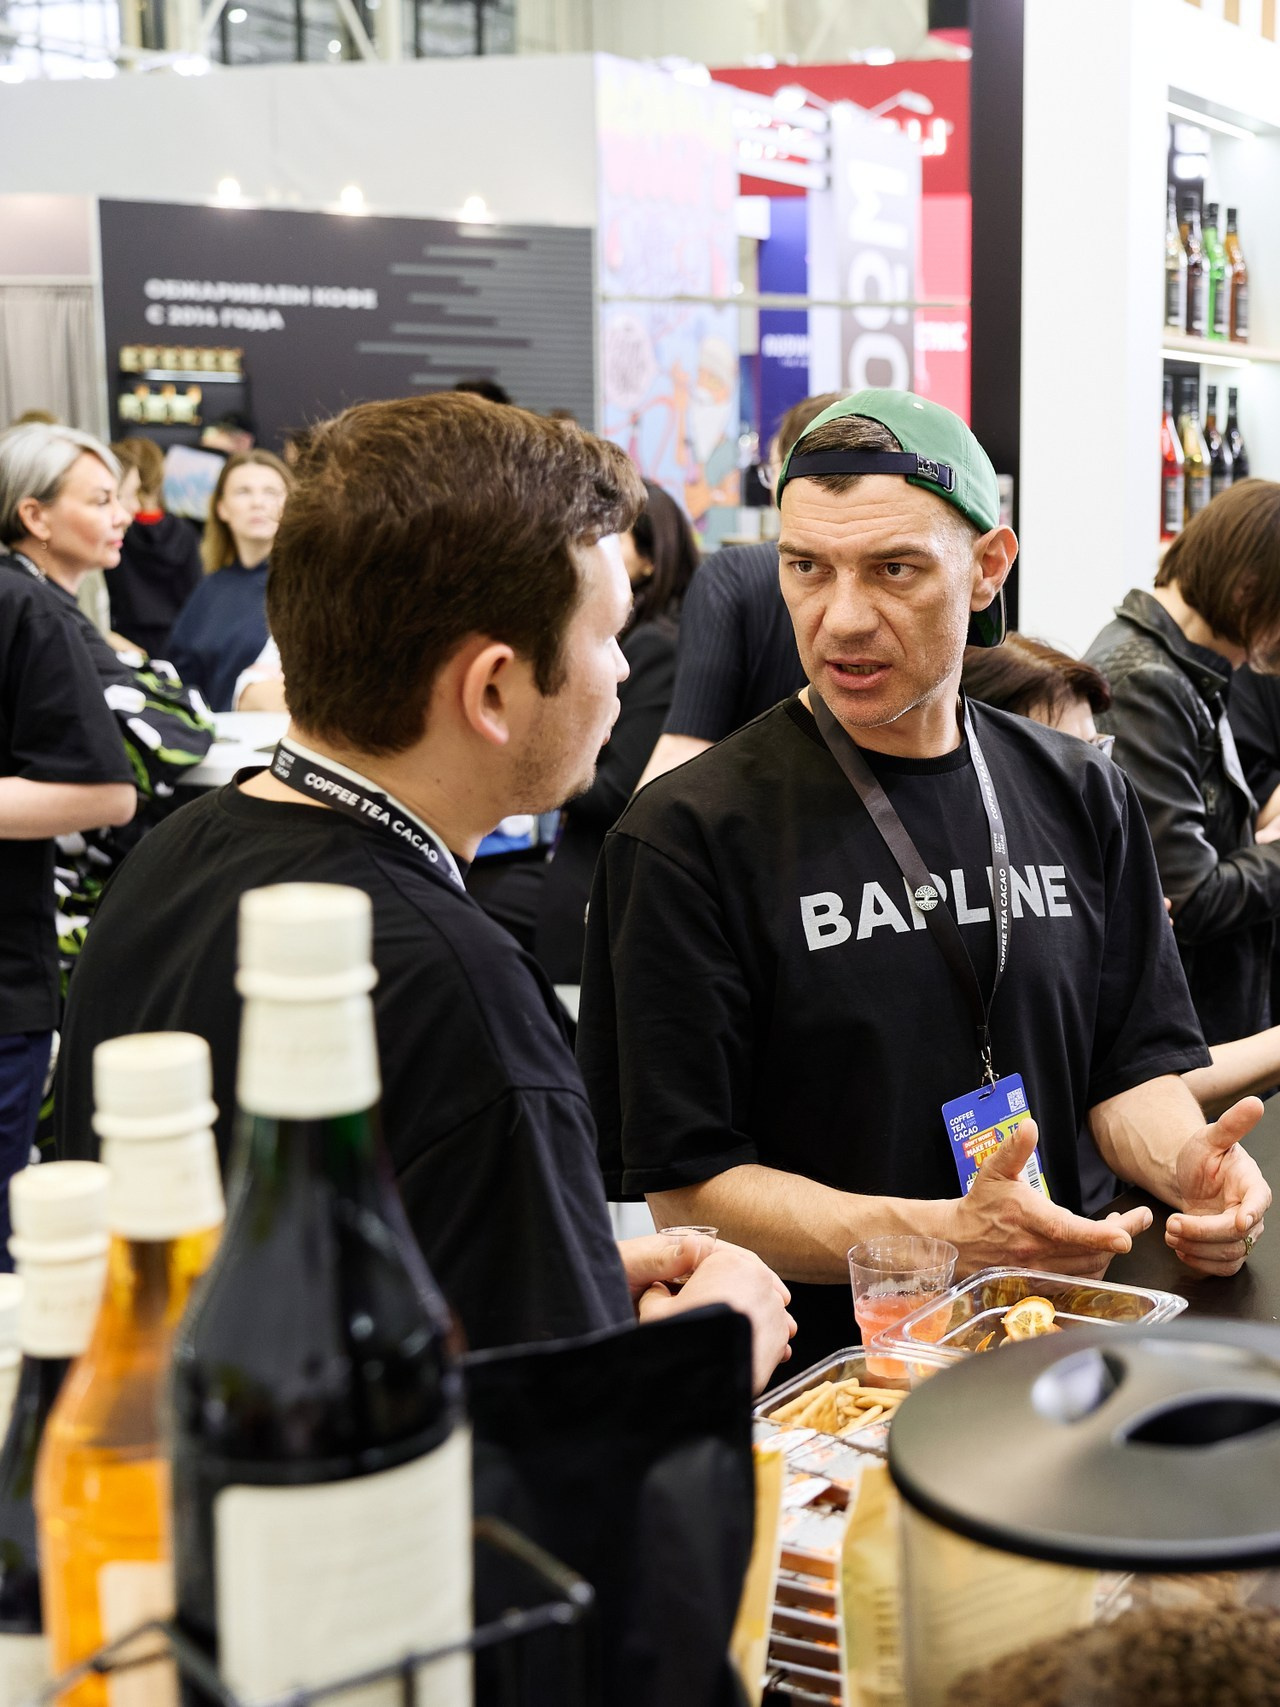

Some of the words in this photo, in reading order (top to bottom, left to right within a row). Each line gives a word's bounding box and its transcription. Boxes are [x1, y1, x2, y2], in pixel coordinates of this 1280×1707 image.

[145, 279, 311, 306] ОБЖАРИВАЕМ
[312, 286, 378, 310] КОФЕ
[219, 306, 285, 332] ГОДА
[979, 765, 989, 783] TEA
[985, 784, 999, 820] COFFEE
[303, 772, 361, 807] COFFEE
[361, 798, 390, 826] TEA
[391, 820, 439, 864] CACAO
[999, 868, 1008, 907] CACAO
[1000, 933, 1008, 973] COFFEE
[949, 1110, 975, 1126] COFFEE
[951, 1123, 967, 1134] TEA
[953, 1126, 979, 1142] CACAO
[966, 1144, 983, 1157] MAKE
[983, 1138, 996, 1151] TEA
